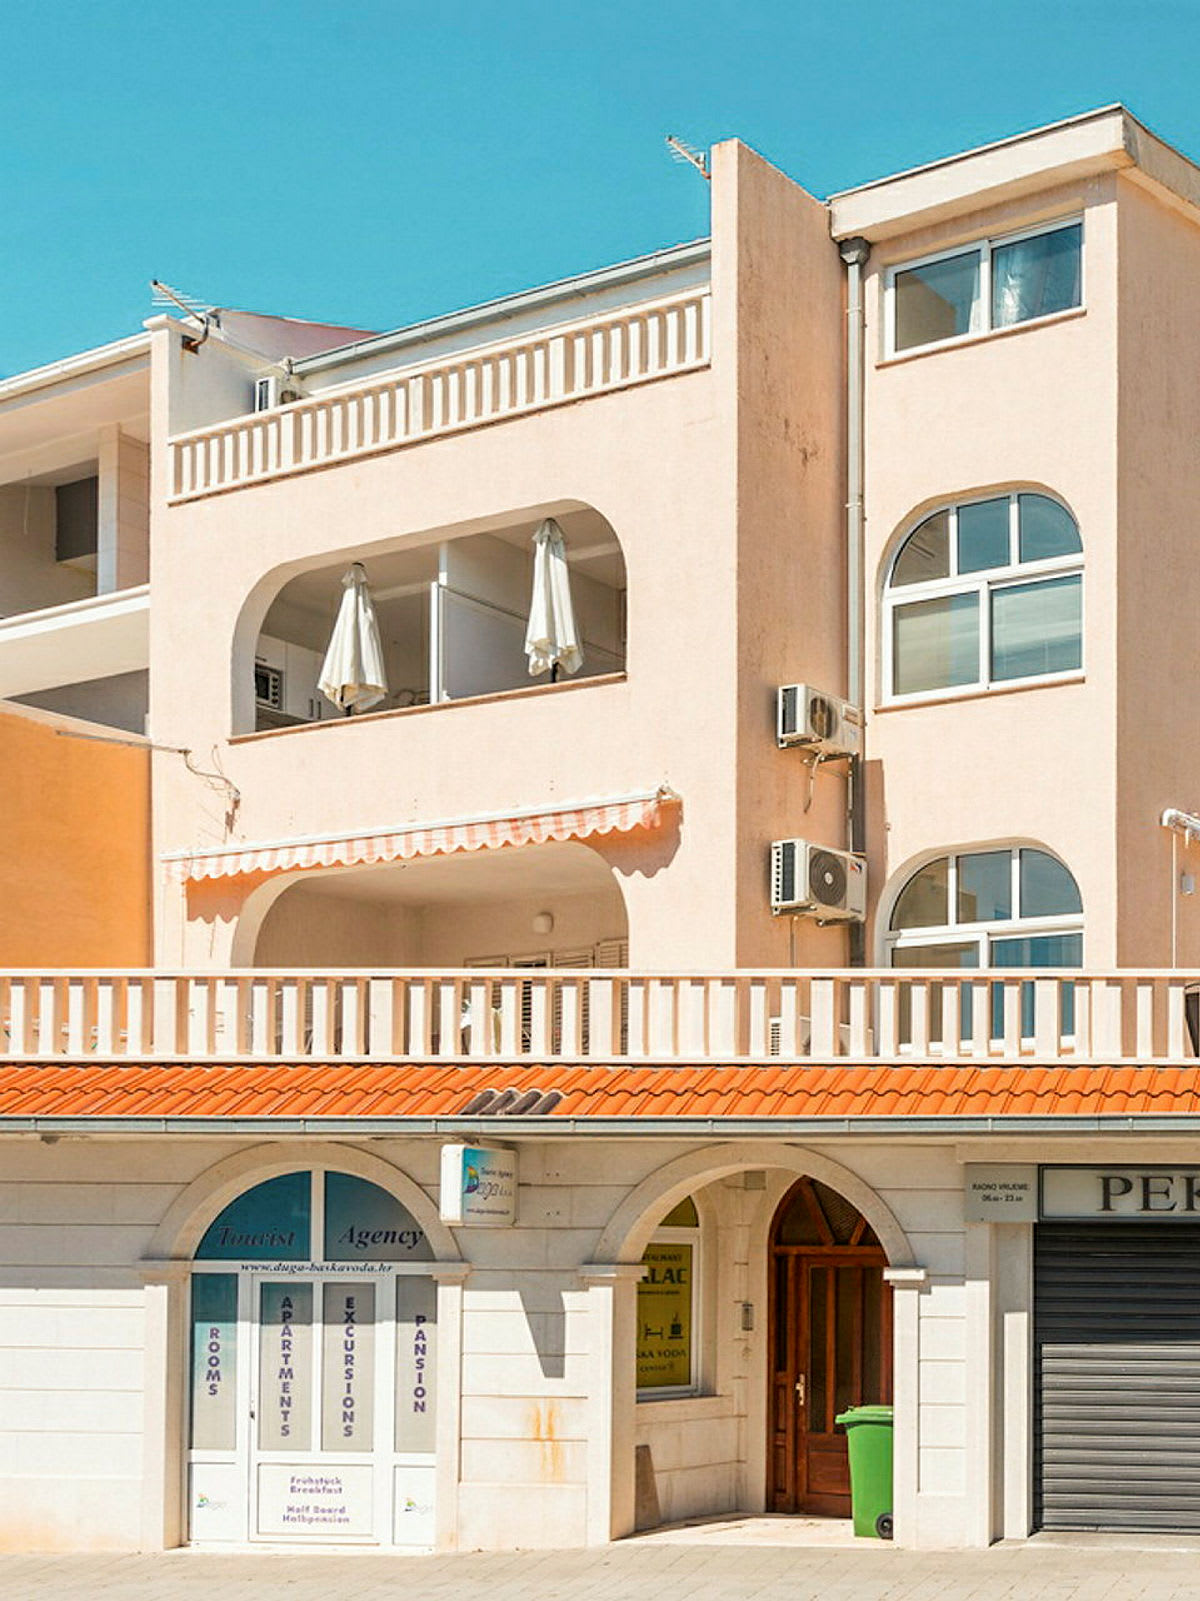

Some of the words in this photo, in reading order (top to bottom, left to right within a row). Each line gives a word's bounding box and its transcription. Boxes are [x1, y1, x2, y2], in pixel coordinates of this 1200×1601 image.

[218, 1226, 296, 1247] Tourist
[338, 1225, 425, 1249] Agency
[241, 1261, 393, 1275] www.duga-baskavoda.hr
[206, 1327, 221, 1396] ROOMS
[278, 1296, 294, 1437] APARTMENTS
[342, 1297, 355, 1437] EXCURSIONS
[413, 1315, 427, 1413] PANSION
[290, 1485, 342, 1494] Breakfast
